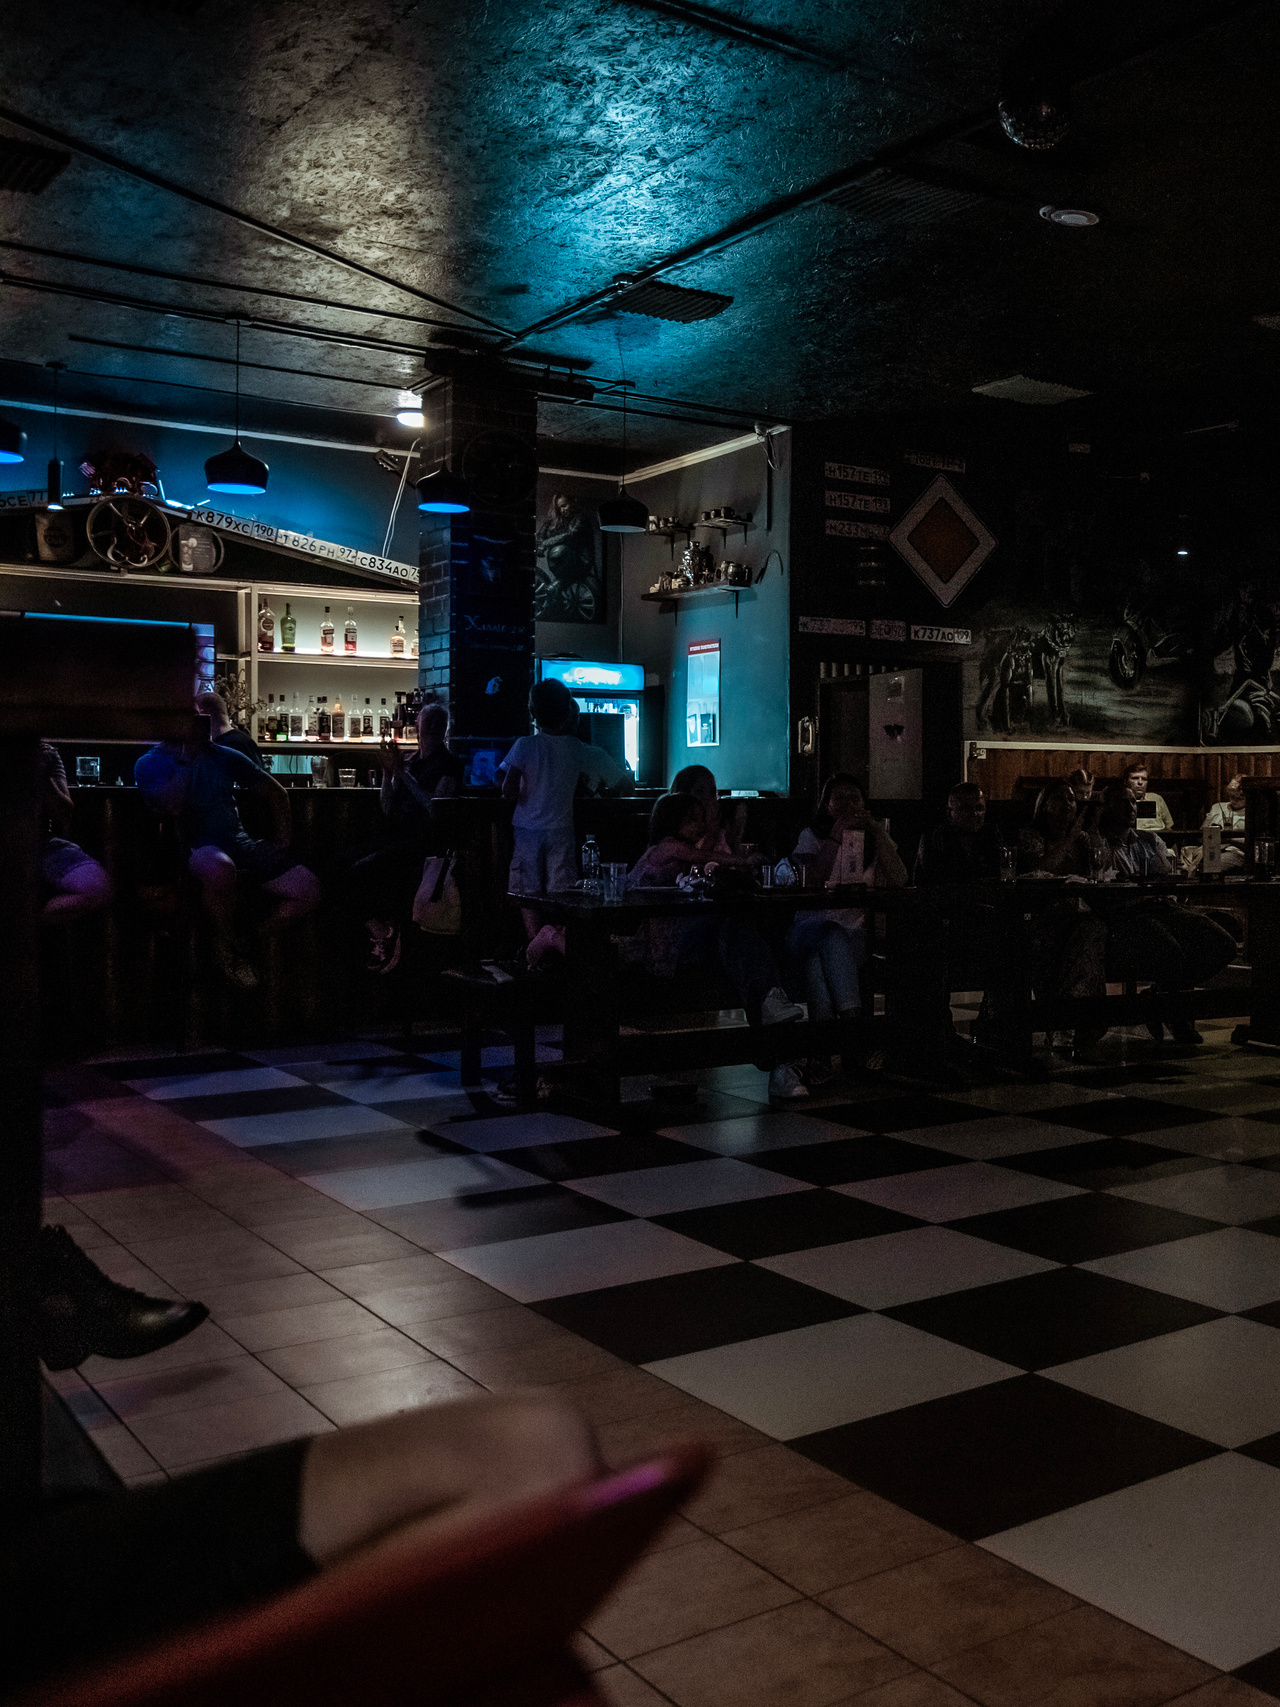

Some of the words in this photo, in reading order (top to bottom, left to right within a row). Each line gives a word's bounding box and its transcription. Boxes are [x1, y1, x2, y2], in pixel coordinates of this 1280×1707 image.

[196, 510, 250, 534] K879XC
[253, 523, 274, 537] 190
[339, 547, 352, 559] 97
[359, 555, 409, 578] C834AO
